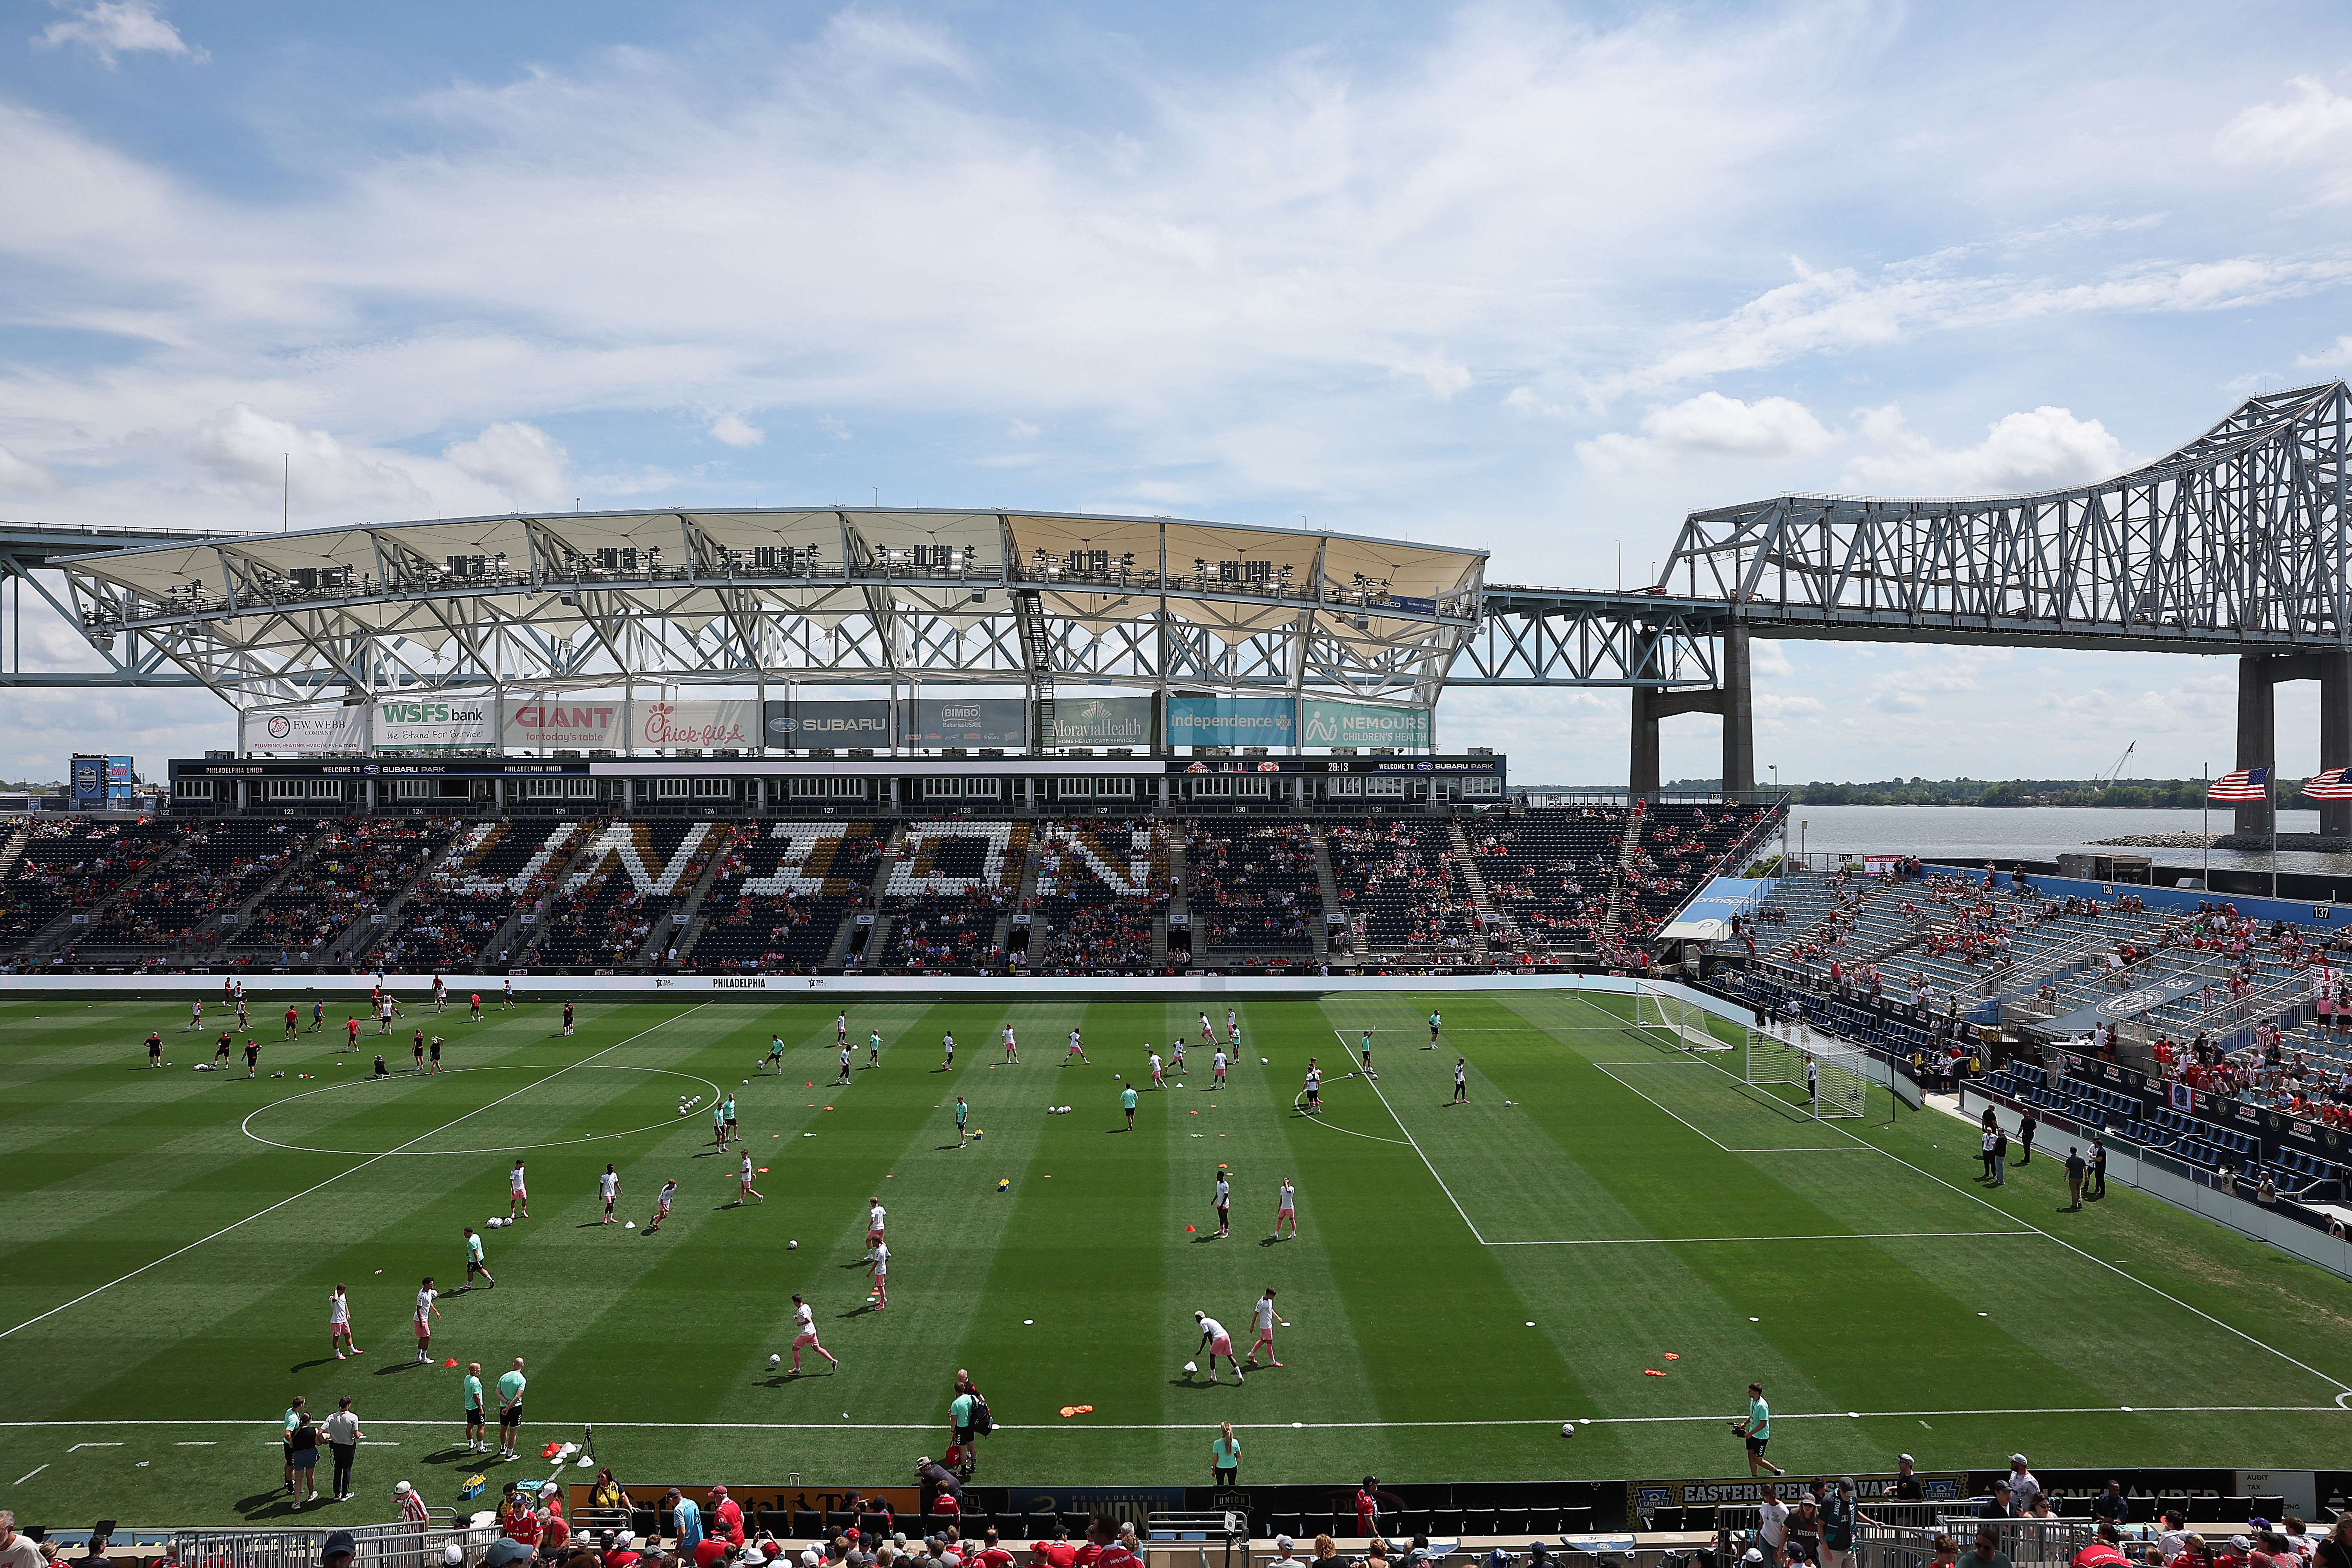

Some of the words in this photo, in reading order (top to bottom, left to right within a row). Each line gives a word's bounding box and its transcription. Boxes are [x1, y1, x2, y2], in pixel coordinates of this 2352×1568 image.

[383, 703, 448, 723] WSFS
[452, 708, 483, 721] bank
[516, 707, 613, 728] GIANT
[945, 709, 978, 717] BIMBO
[273, 722, 285, 732] WEBB
[293, 720, 311, 729] F.W.
[315, 720, 345, 729] WEBB
[802, 718, 886, 731] SUBARU
[1171, 714, 1272, 730] Independence
[1343, 717, 1426, 730] NEMOURS
[387, 730, 399, 740] We
[403, 730, 429, 739] Stand
[433, 730, 447, 739] For
[450, 730, 482, 739] Service
[526, 732, 540, 741] for
[542, 732, 576, 742] today's
[579, 733, 603, 741] table
[1343, 732, 1393, 741] CHILDREN'S
[1395, 733, 1426, 742] HEALTH
[111, 767, 129, 776] Chill
[1328, 763, 1348, 771] 29:13
[433, 822, 1154, 897] UNION
[2103, 885, 2113, 895] 136
[2314, 907, 2329, 918] 137
[713, 978, 766, 988] PHILADELPHIA
[2022, 1028, 2044, 1038] PHILADELPHIA
[2241, 1115, 2260, 1125] Mantecados
[2295, 1124, 2310, 1132] BIMBO
[2296, 1132, 2316, 1142] Mantecados
[1219, 1496, 1245, 1504] UNION
[694, 1509, 700, 1524] 6
[1637, 1506, 1655, 1518] PENNSY
